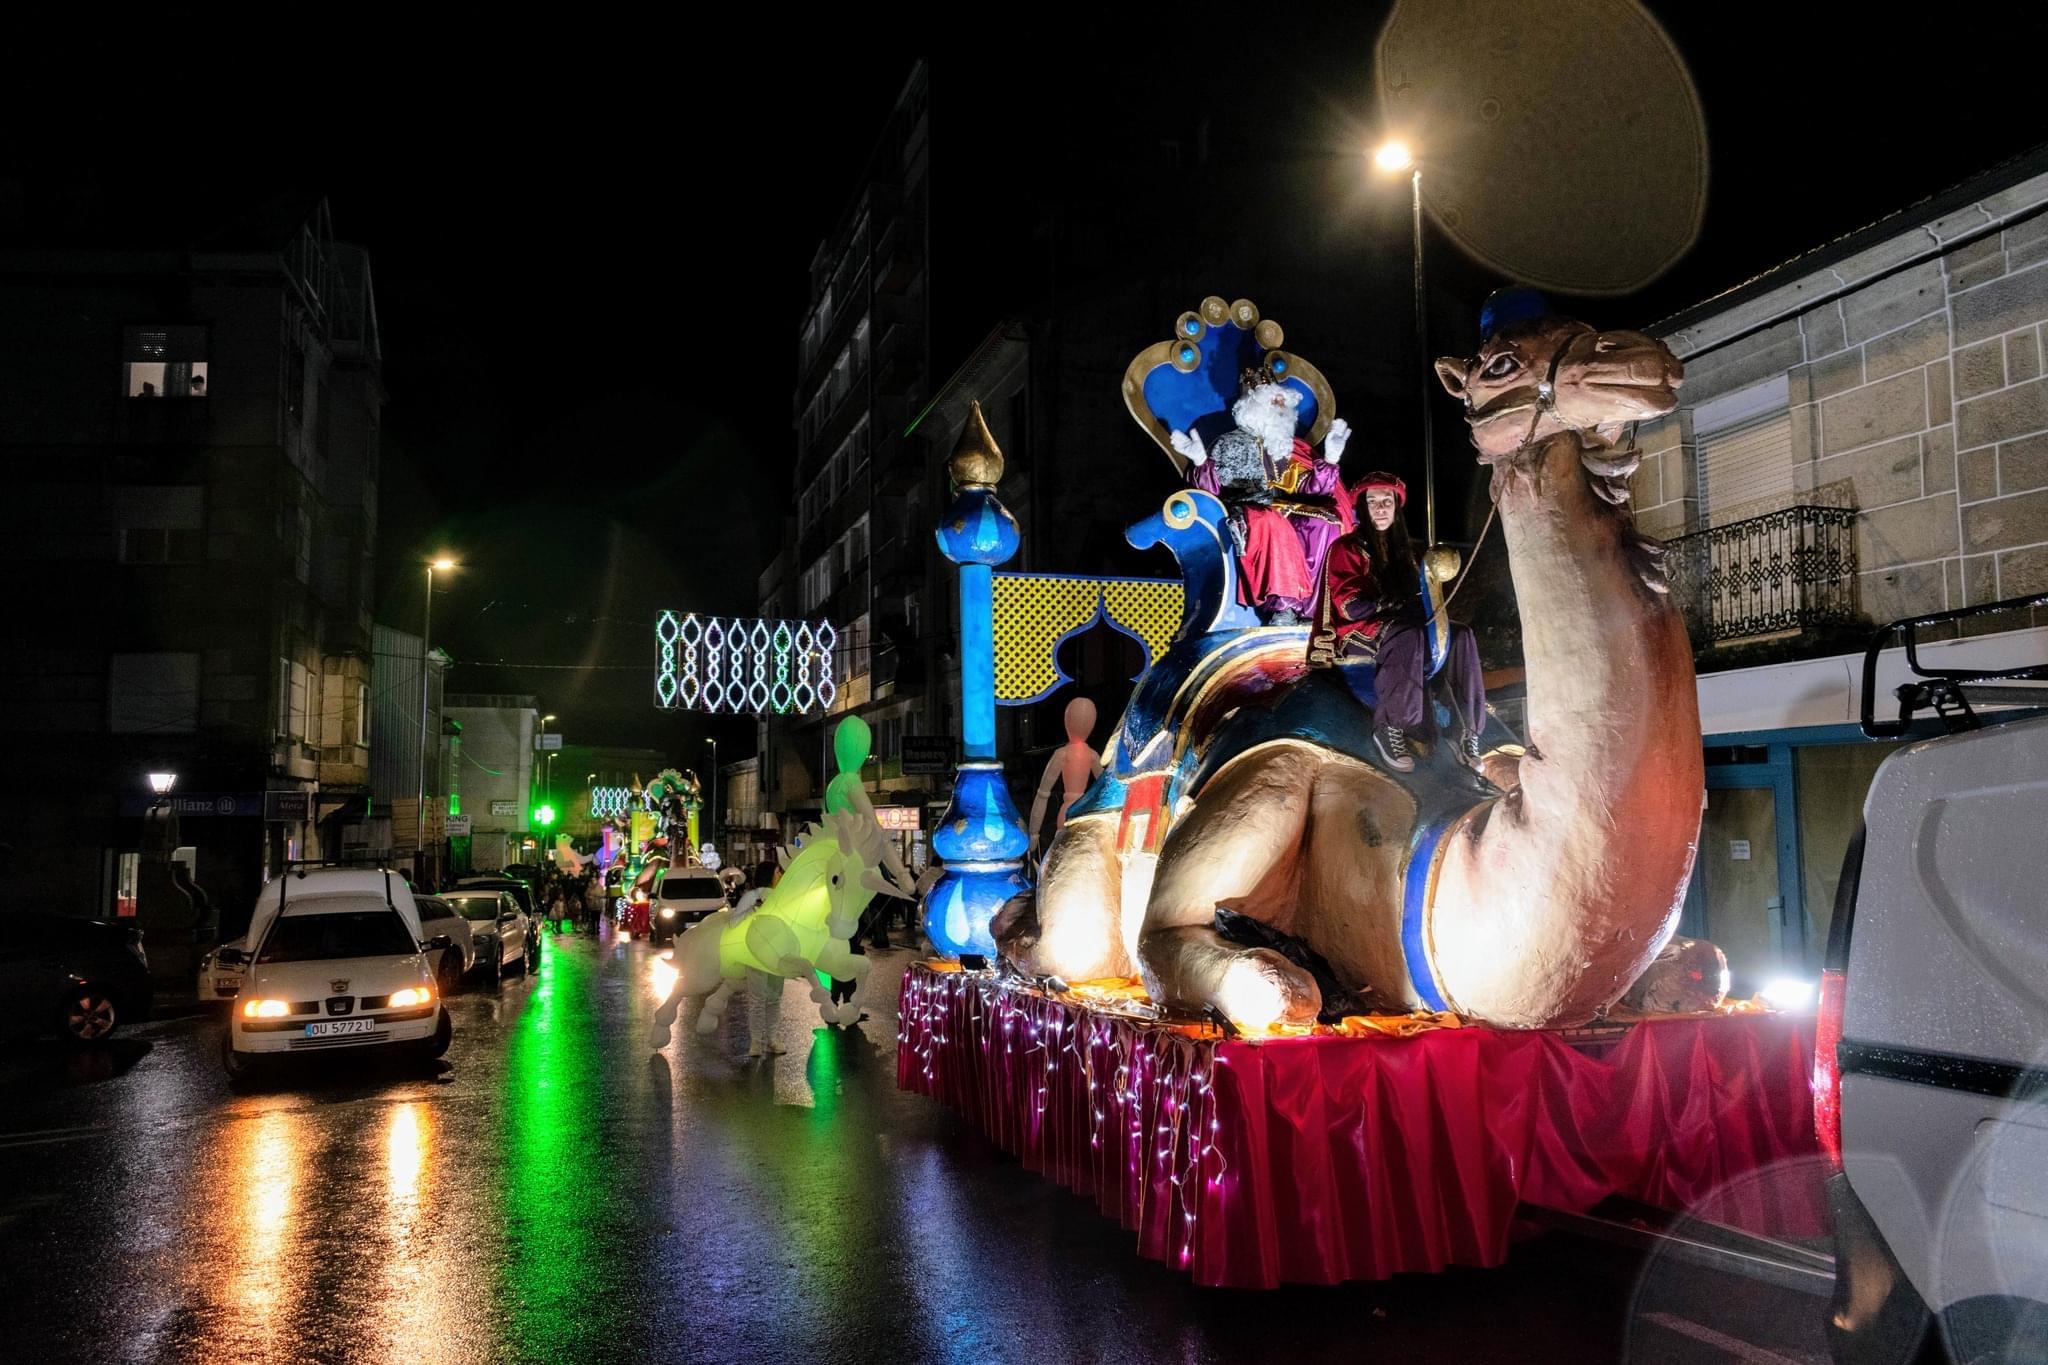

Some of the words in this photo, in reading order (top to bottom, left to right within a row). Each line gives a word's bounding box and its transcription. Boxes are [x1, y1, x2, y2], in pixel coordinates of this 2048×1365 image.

[312, 1024, 327, 1035] OU
[332, 1021, 363, 1033] 5772
[365, 1020, 373, 1031] U
